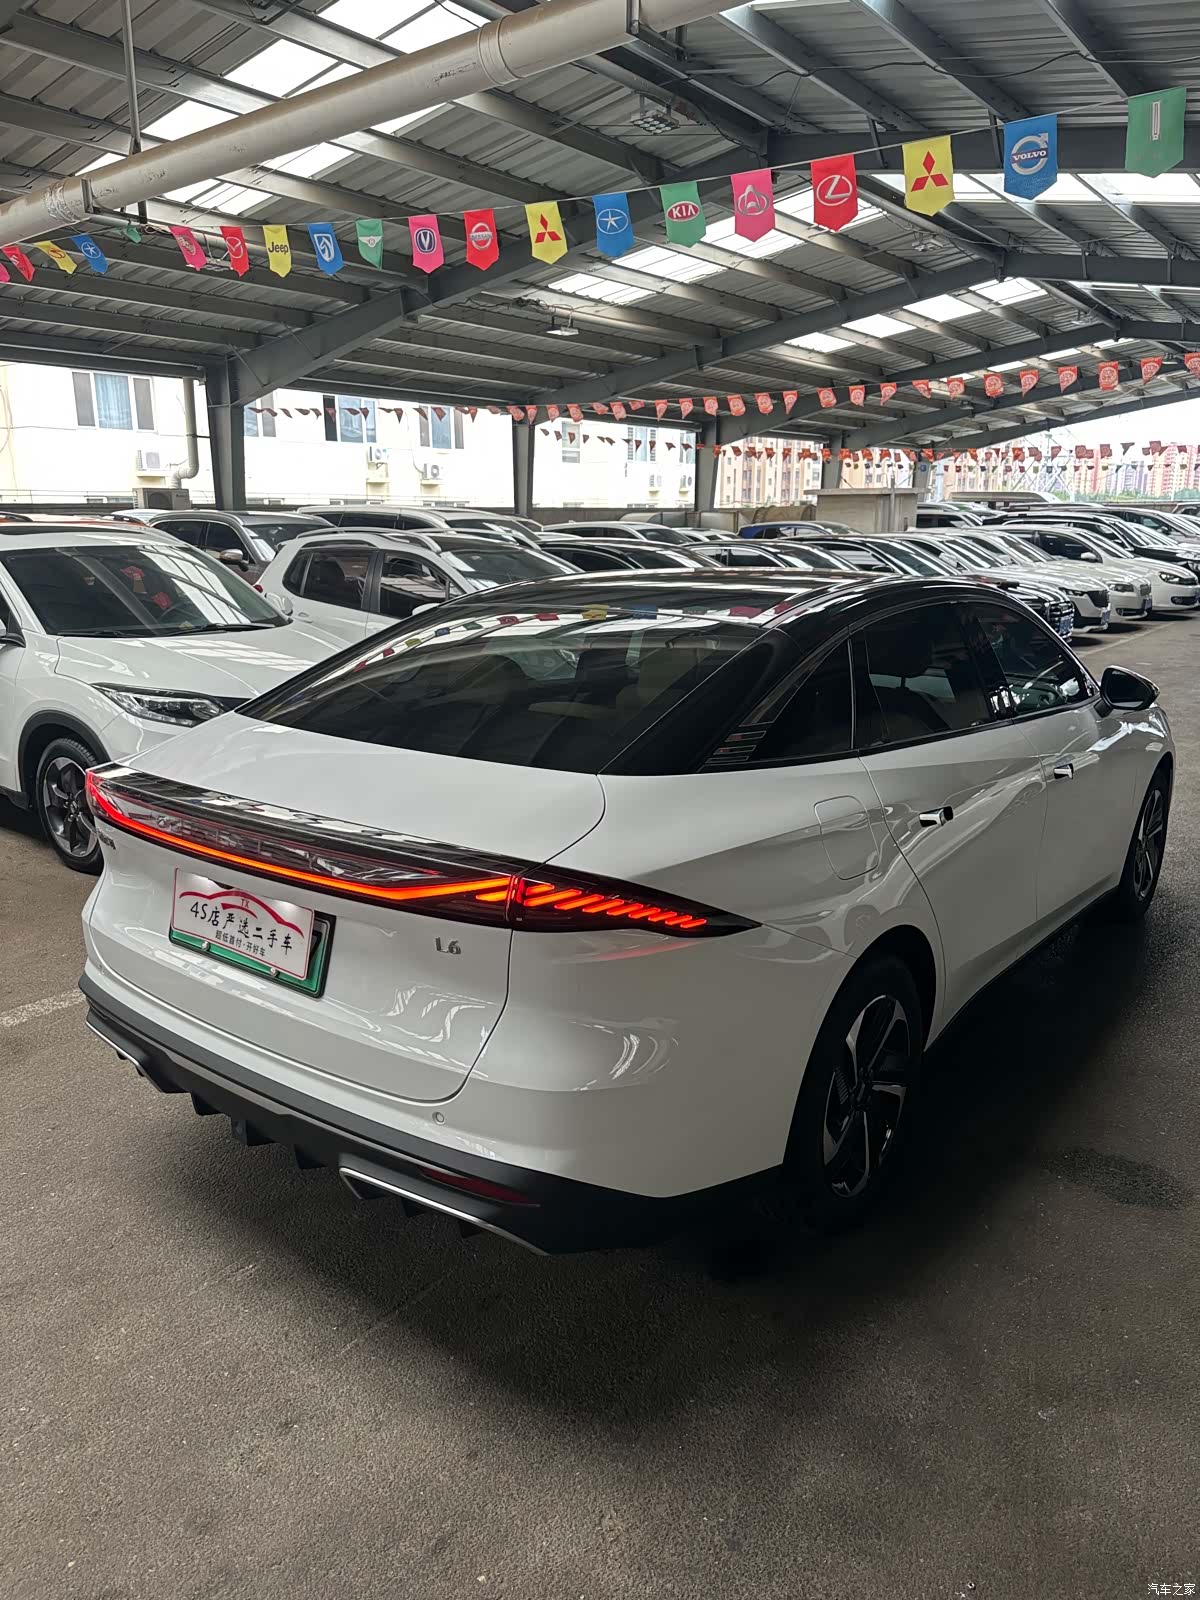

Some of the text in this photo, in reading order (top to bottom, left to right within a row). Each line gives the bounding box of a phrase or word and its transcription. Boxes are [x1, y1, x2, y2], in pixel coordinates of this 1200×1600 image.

[1012, 150, 1047, 161] VOLVO
[672, 204, 696, 219] KIA
[268, 241, 289, 255] Jeep
[241, 898, 250, 909] TX
[190, 901, 293, 955] 4S店严选二手车
[435, 936, 462, 955] L6
